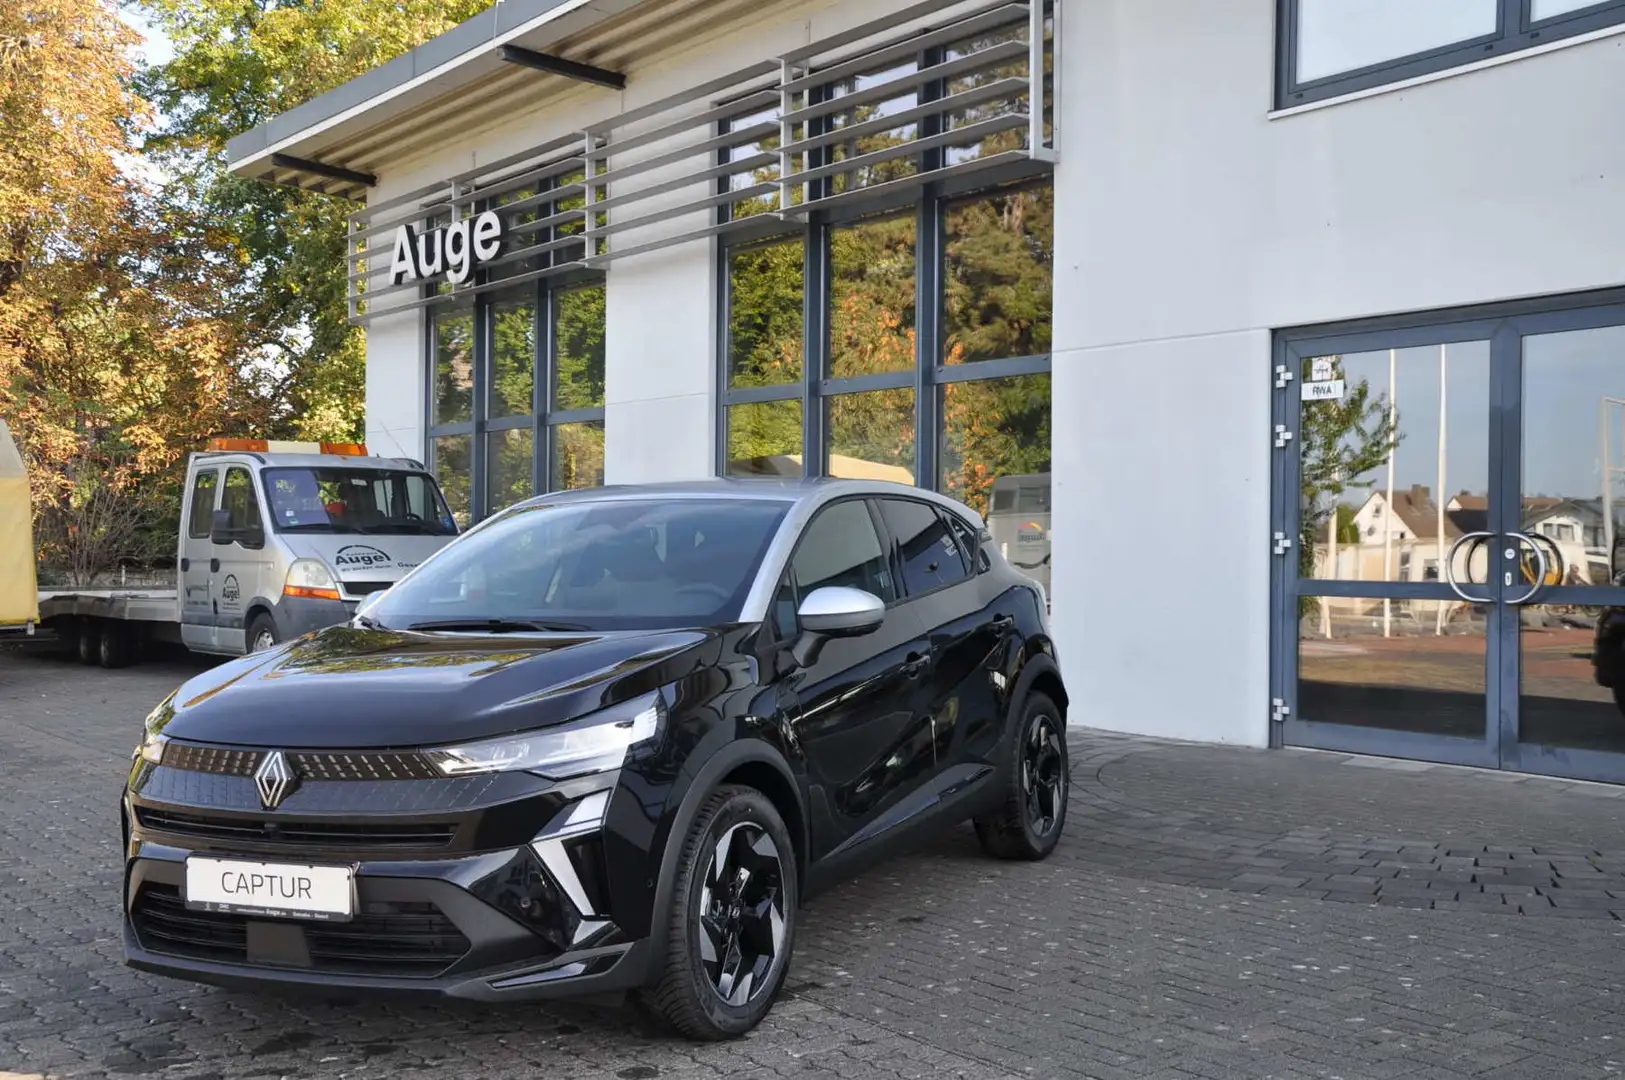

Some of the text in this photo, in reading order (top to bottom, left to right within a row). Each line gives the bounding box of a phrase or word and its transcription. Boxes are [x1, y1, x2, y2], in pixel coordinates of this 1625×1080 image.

[389, 210, 502, 285] Auge
[335, 554, 386, 566] Auge
[221, 871, 312, 900] CAPTUR
